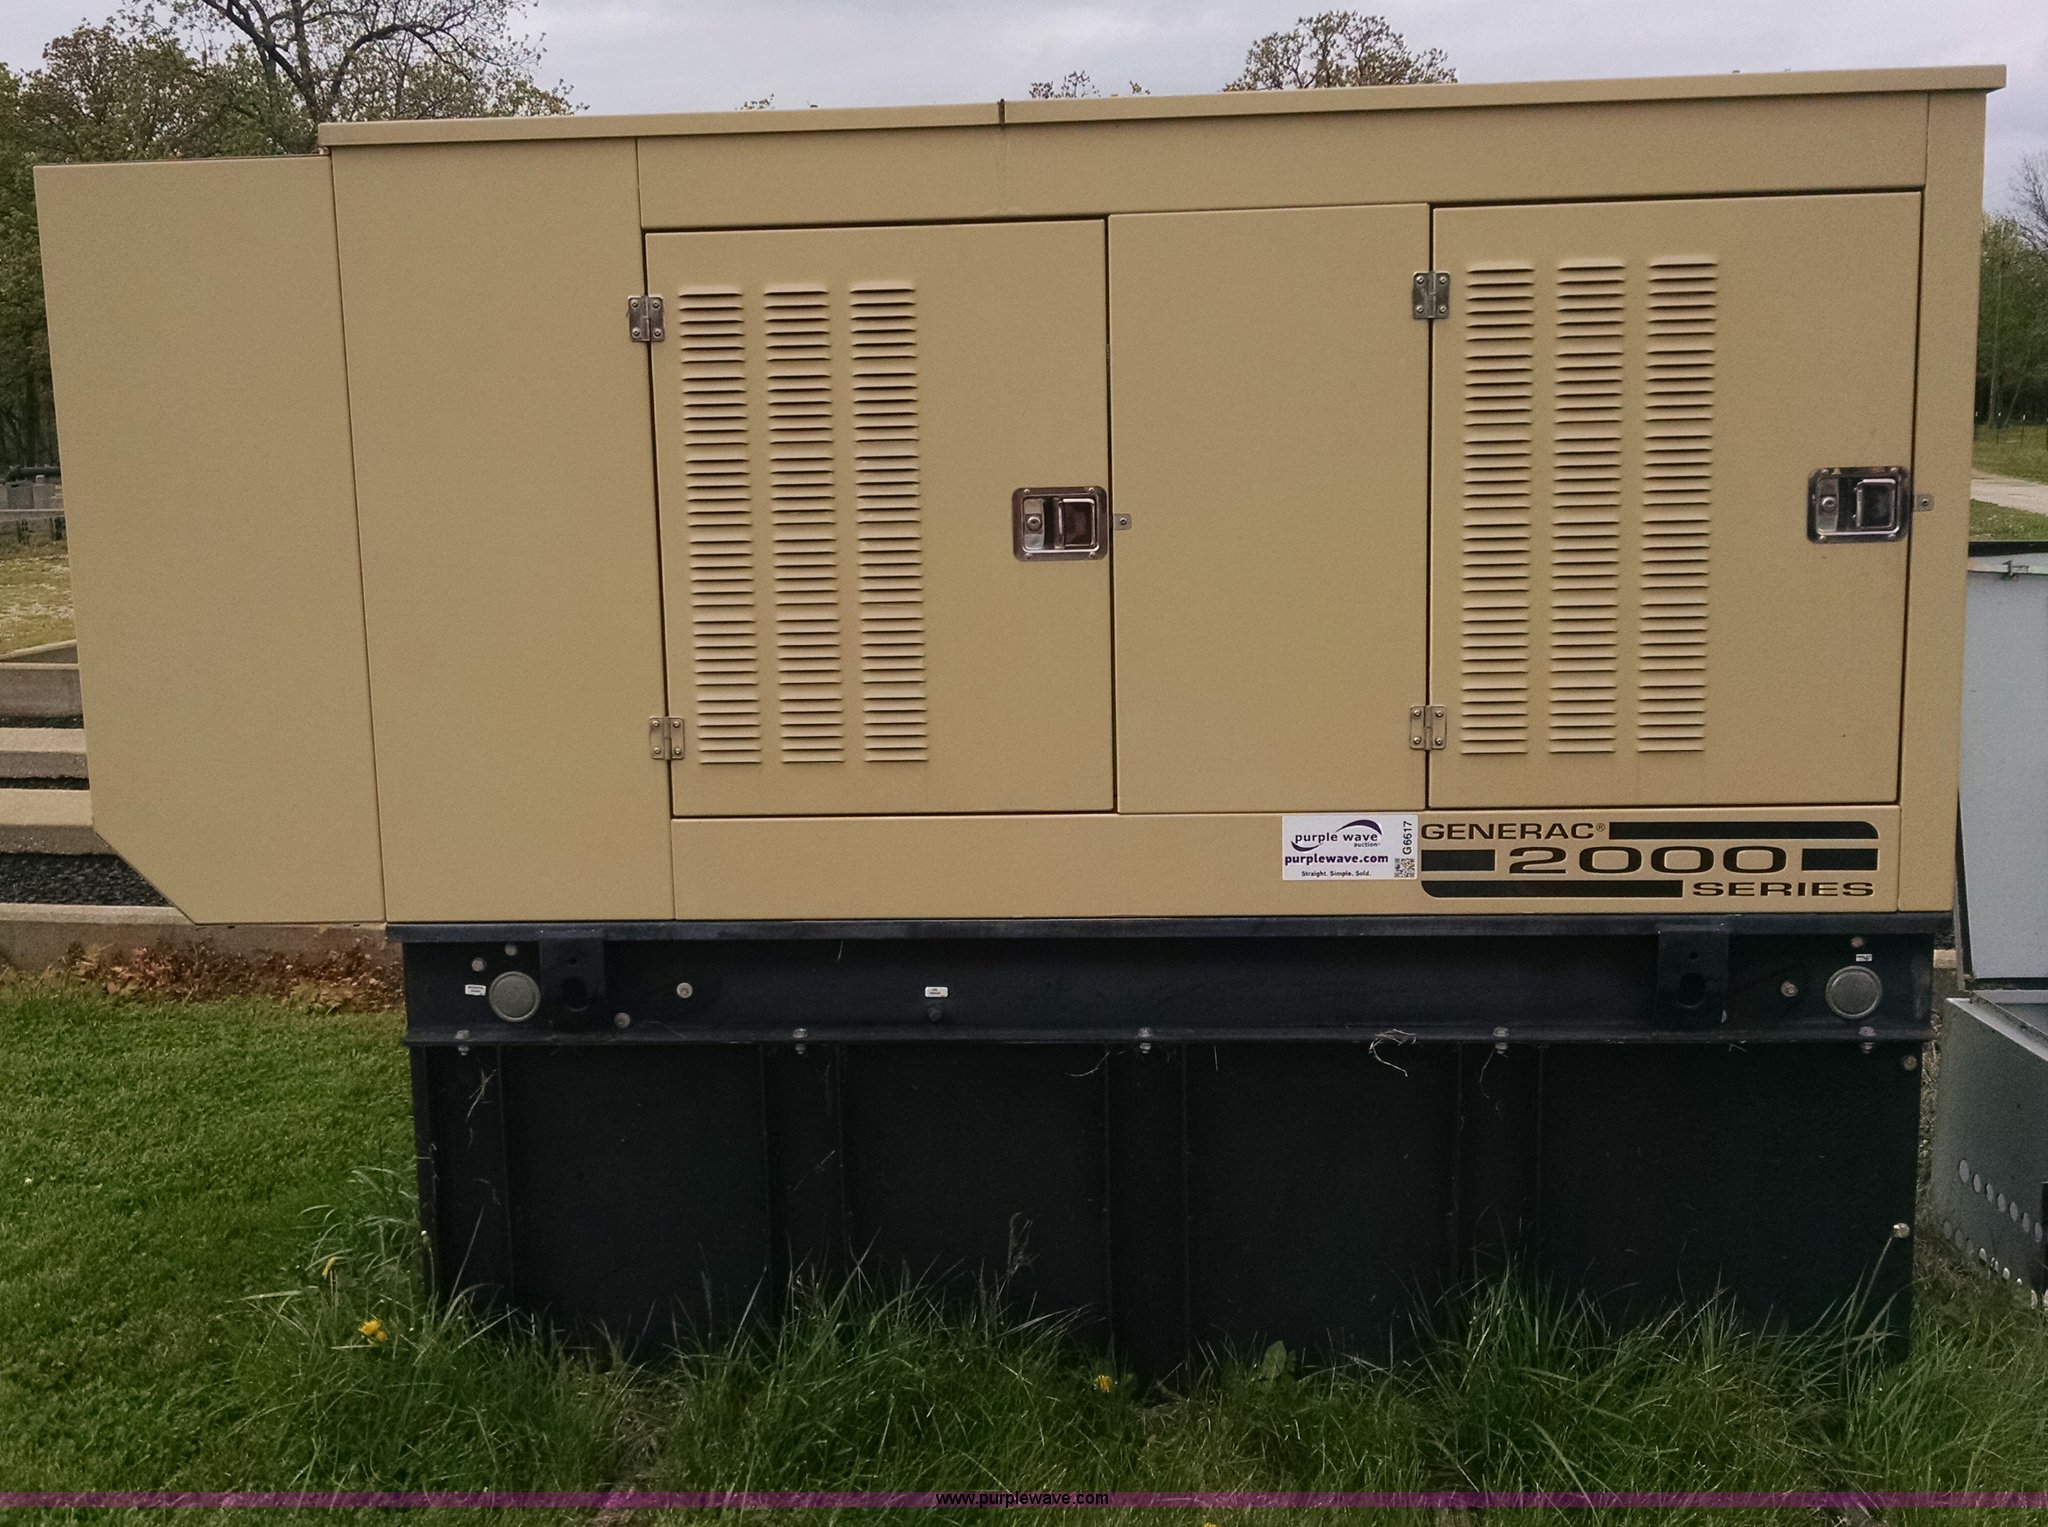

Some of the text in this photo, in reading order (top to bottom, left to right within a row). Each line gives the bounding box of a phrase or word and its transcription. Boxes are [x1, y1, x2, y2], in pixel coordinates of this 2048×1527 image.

[1295, 832, 1378, 844] purple wave
[1402, 821, 1413, 855] G6617
[1284, 853, 1389, 866] purplewave.com
[1508, 845, 1787, 875] 2000
[1301, 870, 1329, 878] Straight.
[1330, 870, 1354, 878] Simple.
[1692, 881, 1875, 898] SERIES
